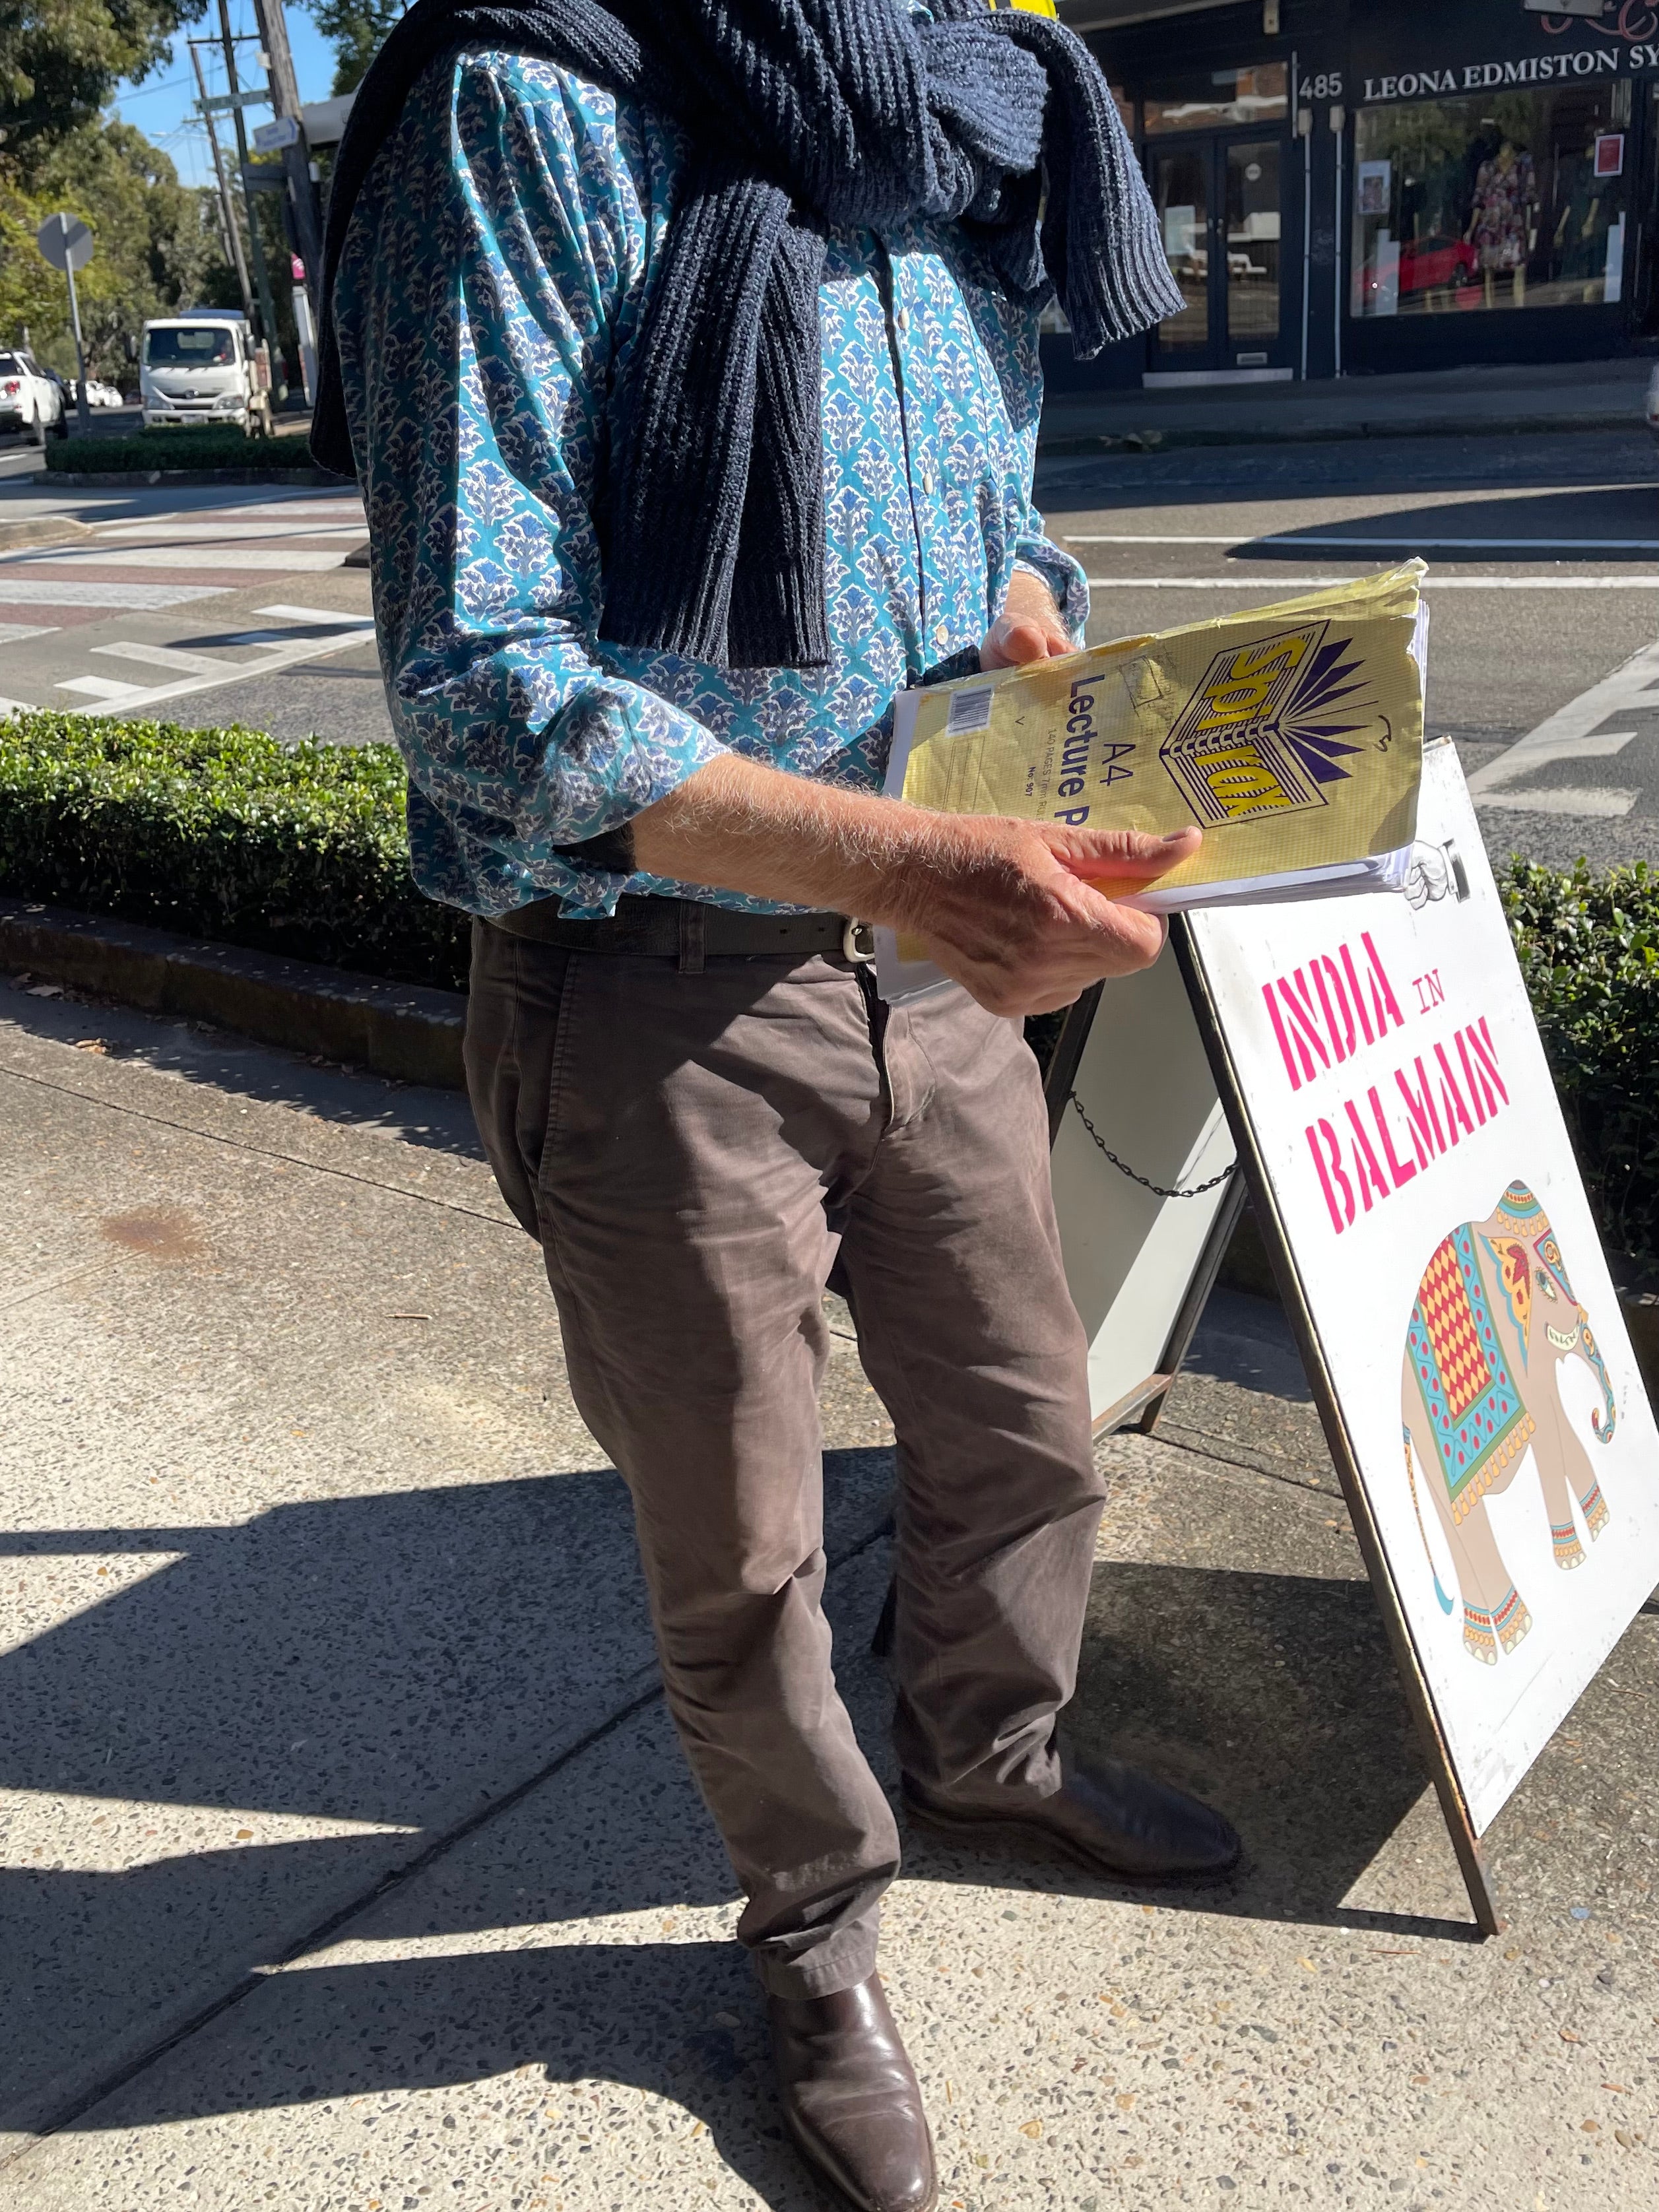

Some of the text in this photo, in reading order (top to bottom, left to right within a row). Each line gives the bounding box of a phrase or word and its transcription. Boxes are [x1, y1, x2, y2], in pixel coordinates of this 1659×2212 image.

[1299, 72, 1343, 100] 485
[1363, 68, 1457, 101] LEONA
[1462, 48, 1619, 88] EDMISTON
[1058, 674, 1105, 797] Lecture
[1194, 636, 1307, 818] Spirax
[1042, 747, 1055, 776] PAGES
[1099, 744, 1136, 787] A4
[1025, 782, 1034, 797] 907
[1262, 930, 1445, 1091] INDIA IN
[1305, 1016, 1510, 1235] BALMAIN
